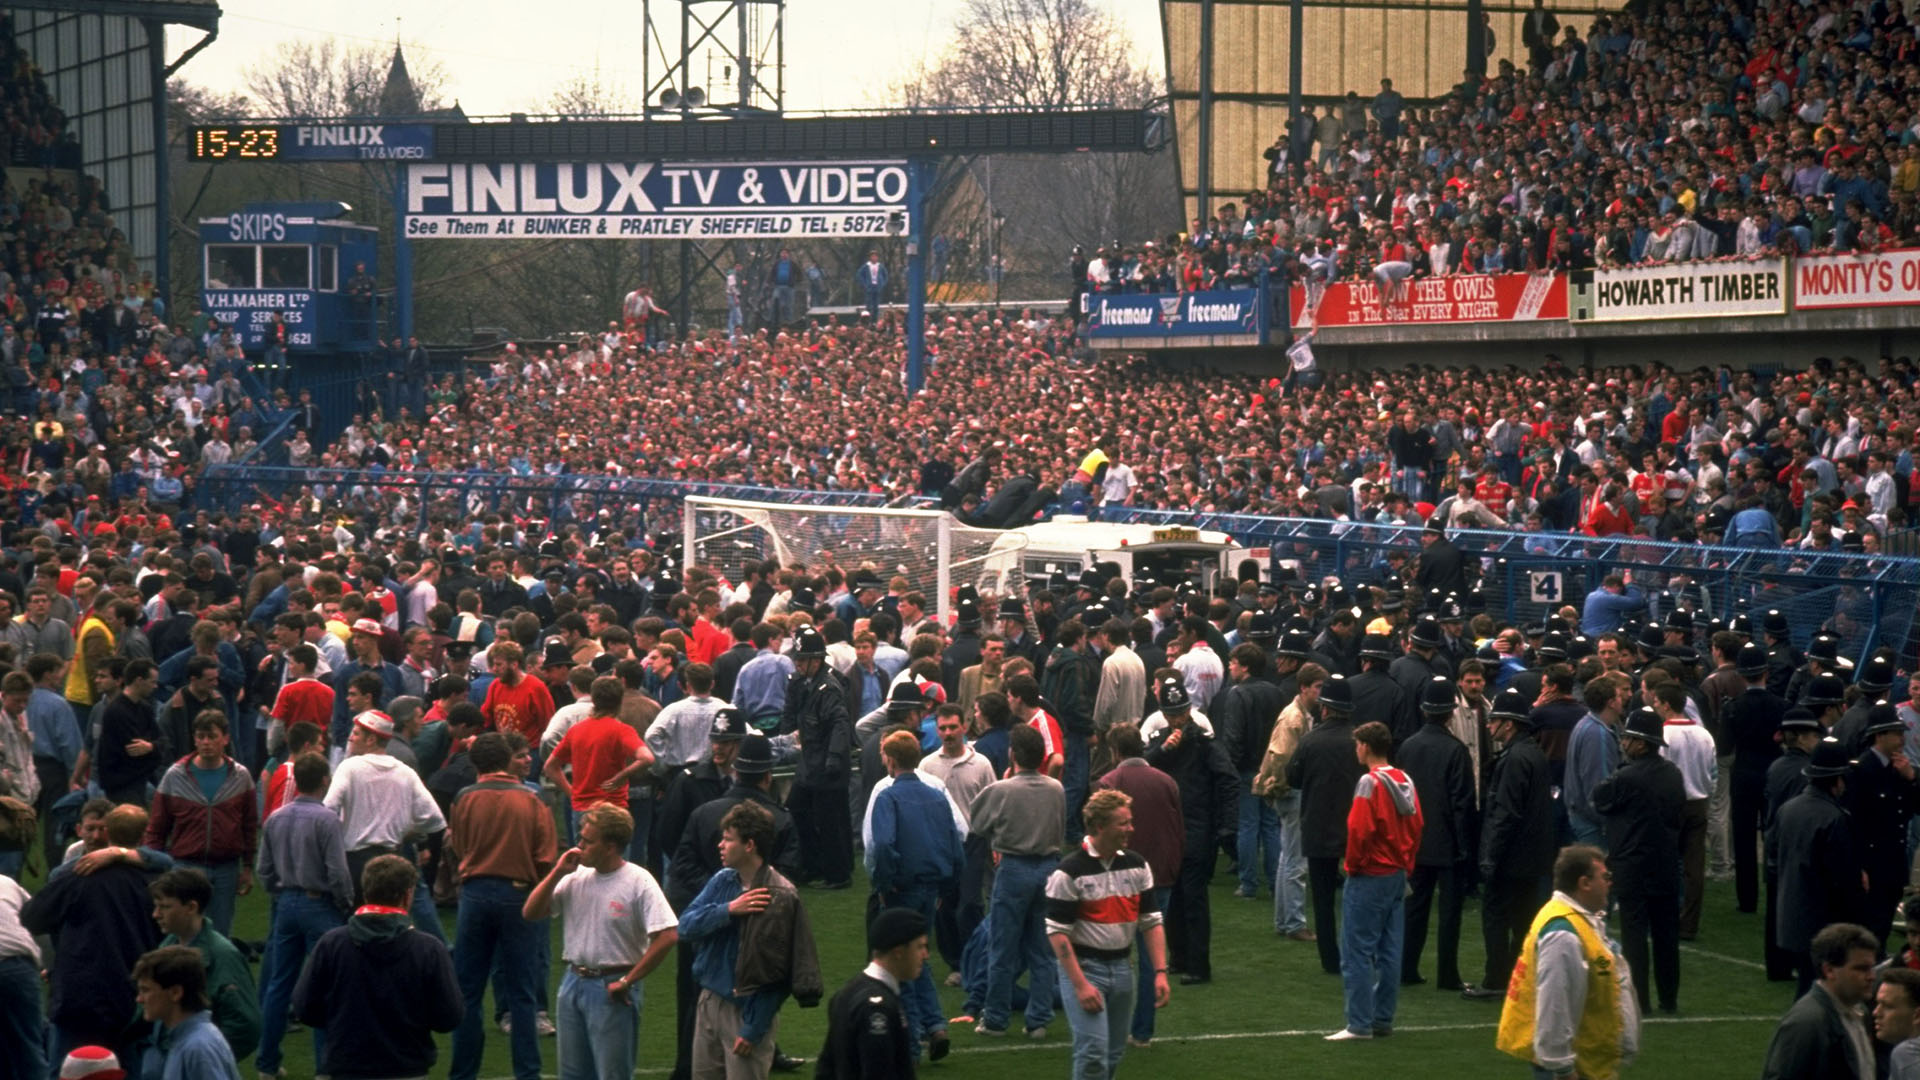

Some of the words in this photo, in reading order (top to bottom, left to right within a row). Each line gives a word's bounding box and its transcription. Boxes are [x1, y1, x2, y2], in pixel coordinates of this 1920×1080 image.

[197, 130, 278, 157] 15-23
[298, 126, 384, 146] FINLUX
[360, 147, 377, 159] TV
[389, 147, 424, 159] VIDEO
[408, 163, 657, 213] FINLUX
[661, 169, 720, 204] TV
[737, 168, 766, 203] &
[780, 167, 909, 203] VIDEO
[229, 213, 286, 241] SKIPS
[408, 218, 438, 235] See
[446, 218, 489, 235] Them
[496, 218, 514, 234] At
[524, 218, 592, 235] BUNKER
[596, 218, 608, 235] &
[620, 218, 694, 235] PRATLEY
[700, 217, 792, 234] SHEFFIELD
[1598, 276, 1694, 308] HOWARTH
[1700, 272, 1780, 303] TIMBER
[1802, 258, 1894, 296] MONTY'S
[1901, 259, 1920, 292] O
[1349, 281, 1411, 304] FOLOW
[1416, 280, 1447, 302] THE
[1453, 277, 1496, 300] OWLS
[214, 311, 240, 323] SKIP
[251, 311, 303, 323] SERCES
[1101, 299, 1153, 325] freemans
[1188, 296, 1241, 322] freemans
[1413, 303, 1454, 320] EVERY
[1458, 301, 1499, 319] NIGHT
[1536, 574, 1558, 600] 4
